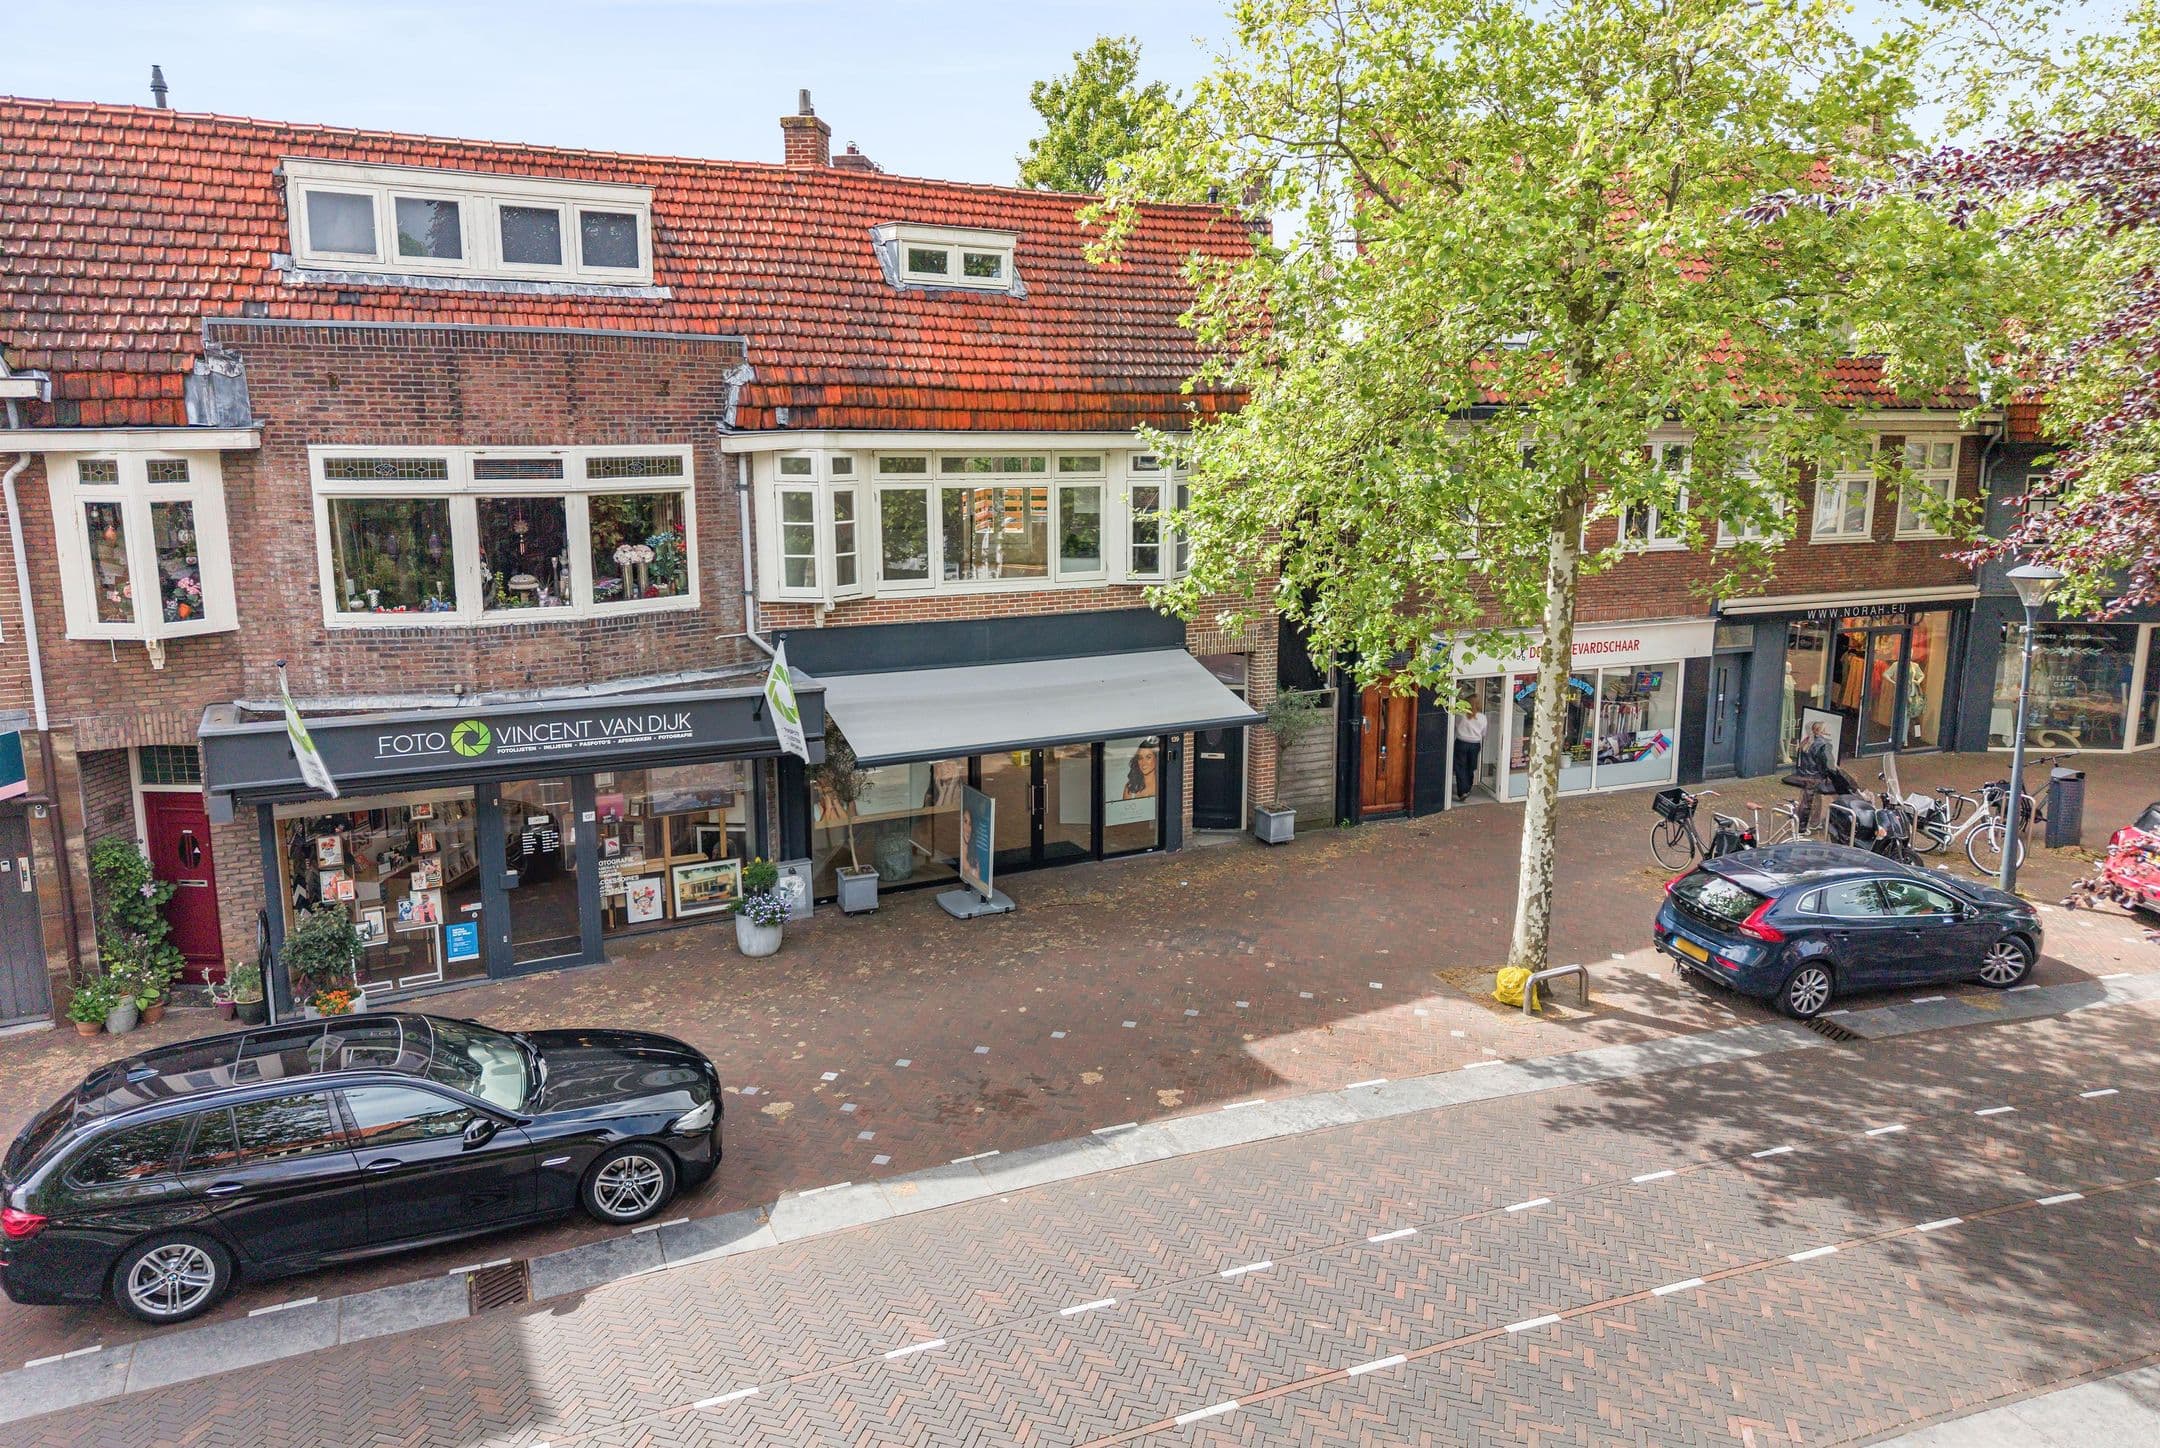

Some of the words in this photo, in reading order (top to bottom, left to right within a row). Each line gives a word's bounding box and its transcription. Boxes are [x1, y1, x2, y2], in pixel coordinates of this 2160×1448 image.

[1807, 604, 1906, 619] WWW.NORAH.EU
[1572, 639, 1640, 655] EVARDSCHAAR
[378, 732, 446, 755] FOTO
[496, 719, 593, 744] VINCENT
[600, 716, 642, 736] VAN
[649, 712, 692, 731] DIJK
[497, 746, 537, 754] FOTOLIJSTEN
[579, 739, 611, 747] PASFOTO'S
[658, 732, 693, 740] FOTOGRAFIE
[598, 856, 635, 866] OTOGRAFIE
